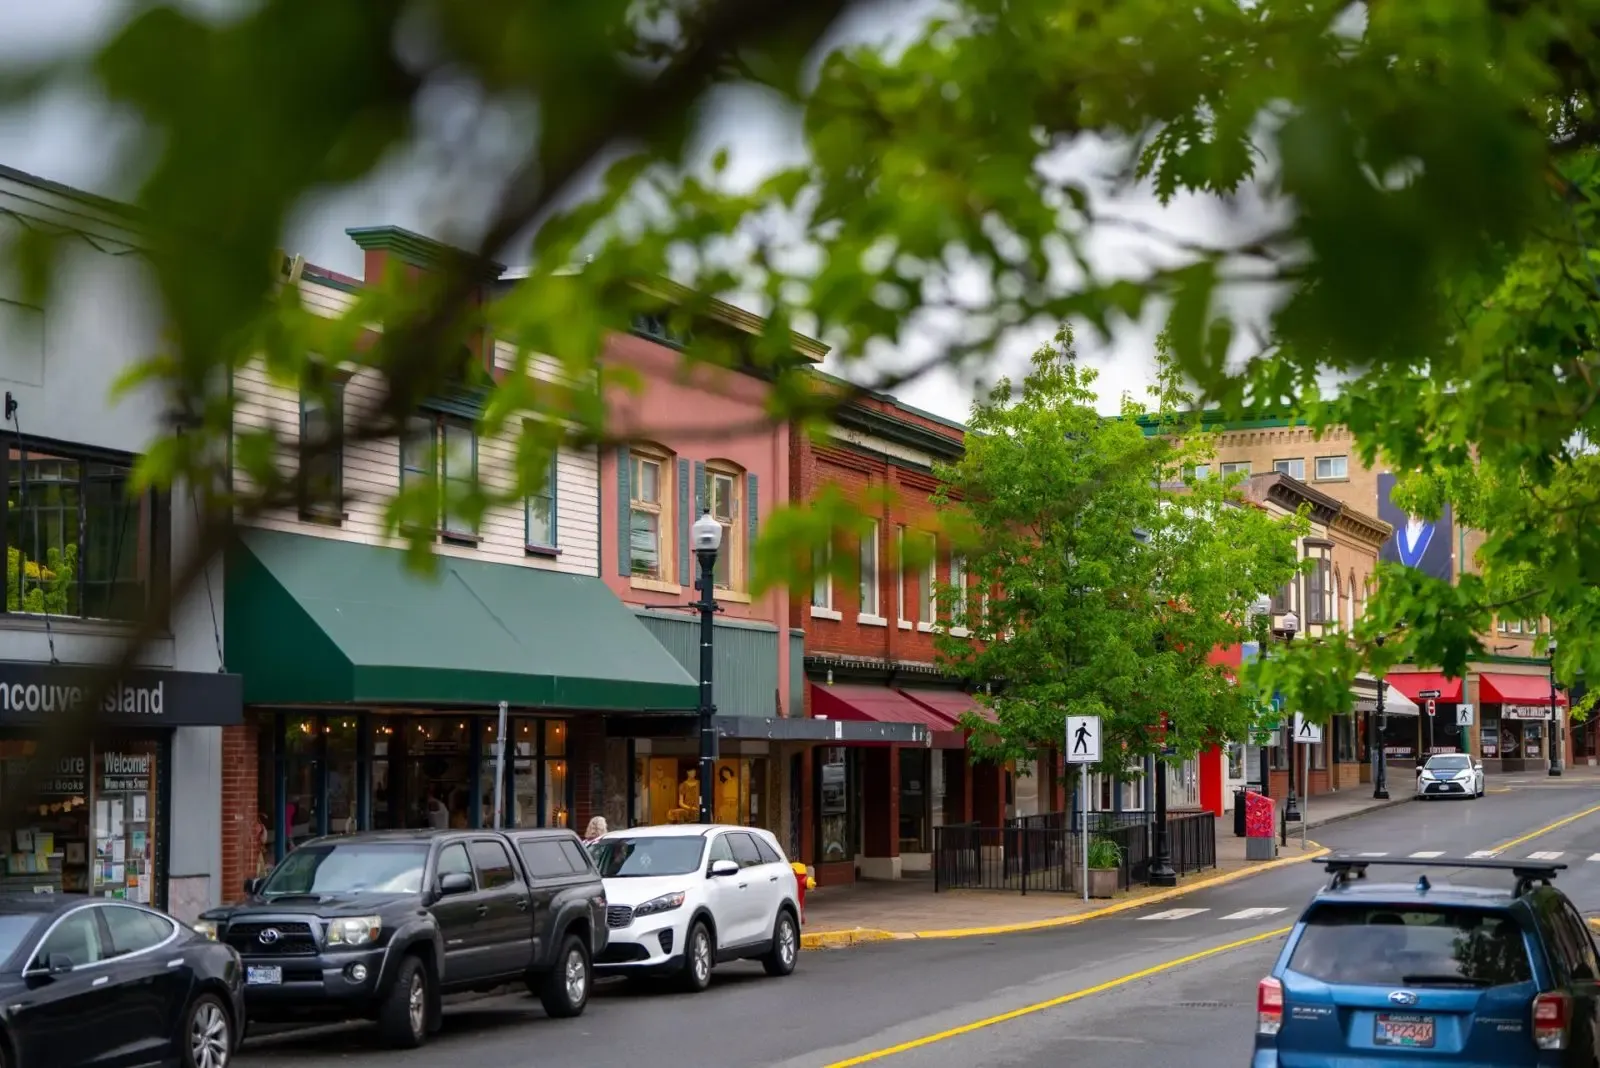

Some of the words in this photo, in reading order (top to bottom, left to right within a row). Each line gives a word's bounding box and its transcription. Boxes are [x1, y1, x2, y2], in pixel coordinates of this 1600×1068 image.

[0, 681, 90, 712] ncouve
[104, 752, 149, 773] Welcome!
[54, 779, 84, 790] Books
